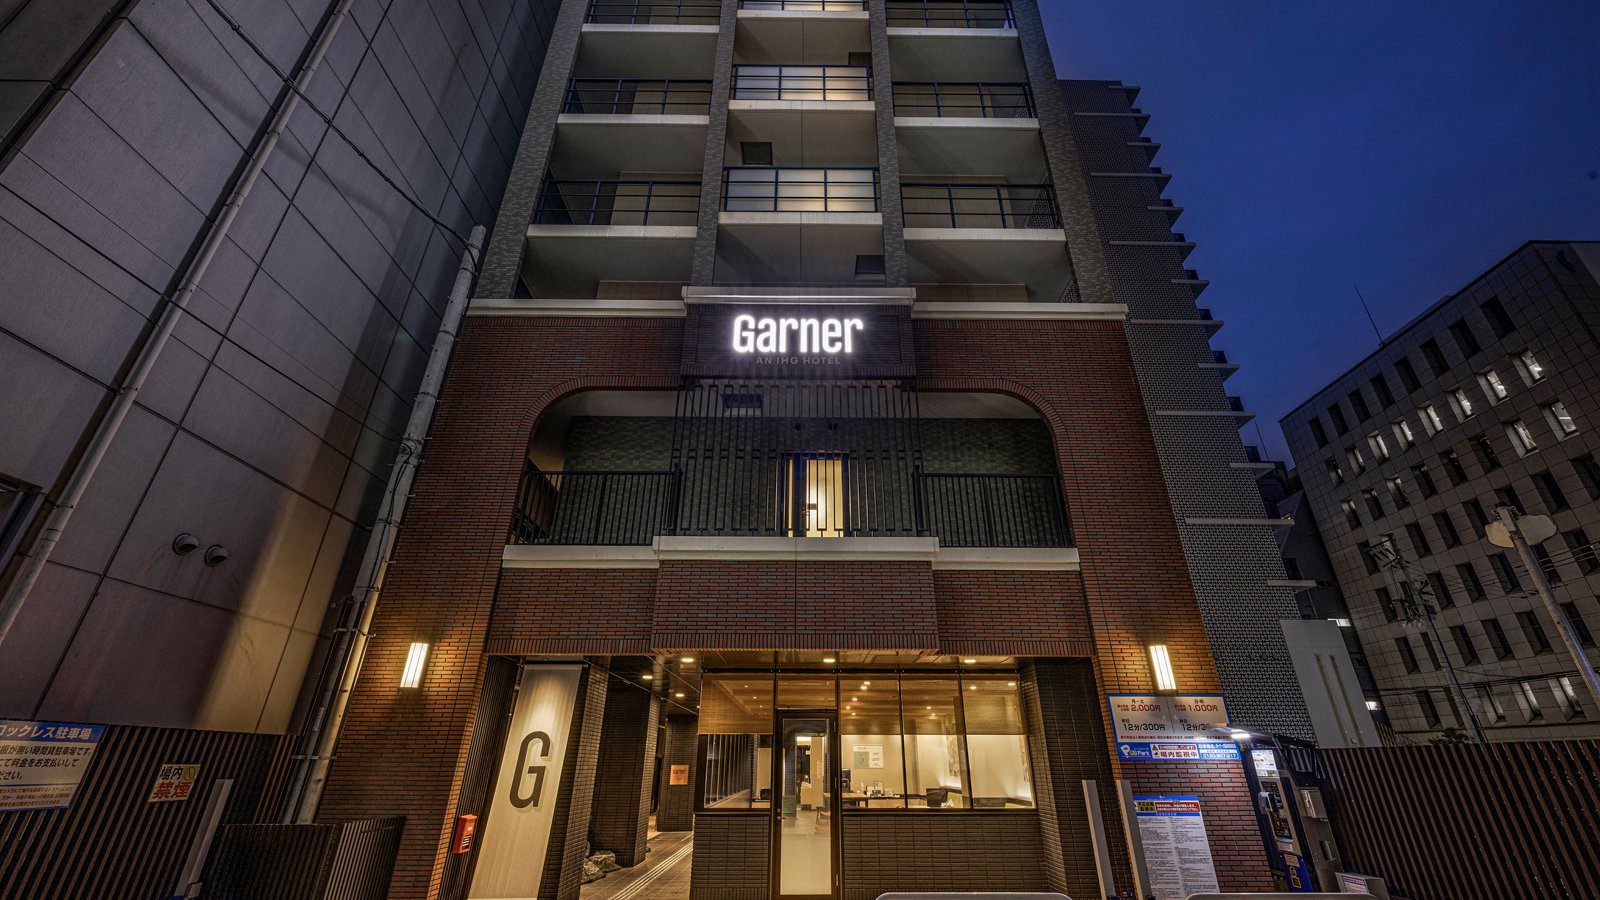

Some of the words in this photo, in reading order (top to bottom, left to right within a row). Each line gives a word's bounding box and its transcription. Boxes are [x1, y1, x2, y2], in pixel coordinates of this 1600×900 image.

[733, 314, 863, 353] Garner
[756, 356, 772, 365] AN
[776, 356, 799, 365] IHG
[803, 356, 841, 365] HOTEL
[1182, 723, 1210, 731] 12分/3
[160, 766, 184, 780] 場内
[509, 730, 551, 809] G
[151, 781, 192, 799] 禁煙
